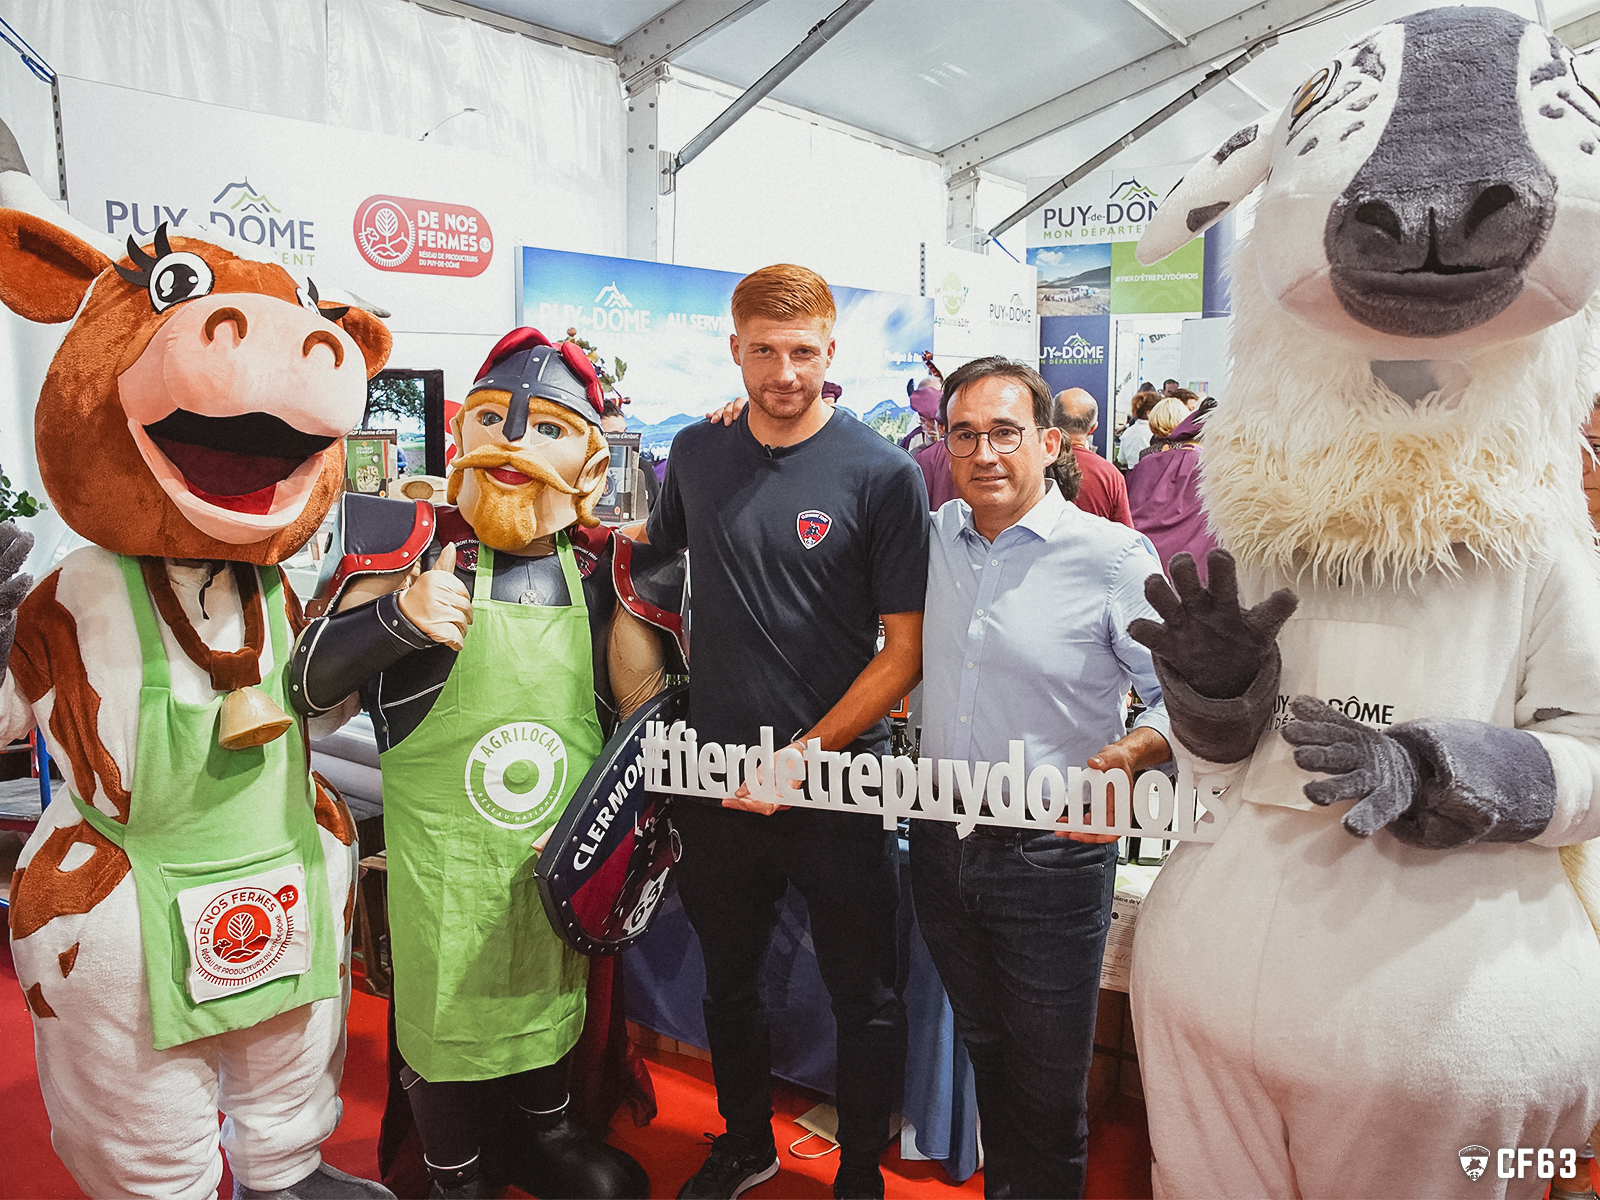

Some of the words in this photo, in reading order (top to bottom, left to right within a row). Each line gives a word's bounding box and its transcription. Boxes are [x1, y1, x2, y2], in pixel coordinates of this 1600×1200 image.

[417, 209, 440, 230] DE
[444, 213, 478, 234] NOS
[418, 230, 478, 252] FERMES
[1043, 230, 1073, 240] MON
[480, 727, 560, 758] AGRILOCAL
[641, 720, 1229, 841] #fierdetrepuydomois
[515, 789, 557, 821] NATIONAL
[232, 891, 277, 912] FERMES
[280, 891, 295, 903] 63
[204, 898, 229, 925] NOS
[200, 927, 210, 945] DE
[213, 964, 222, 972] DE
[221, 958, 265, 975] PRODUCTEURS
